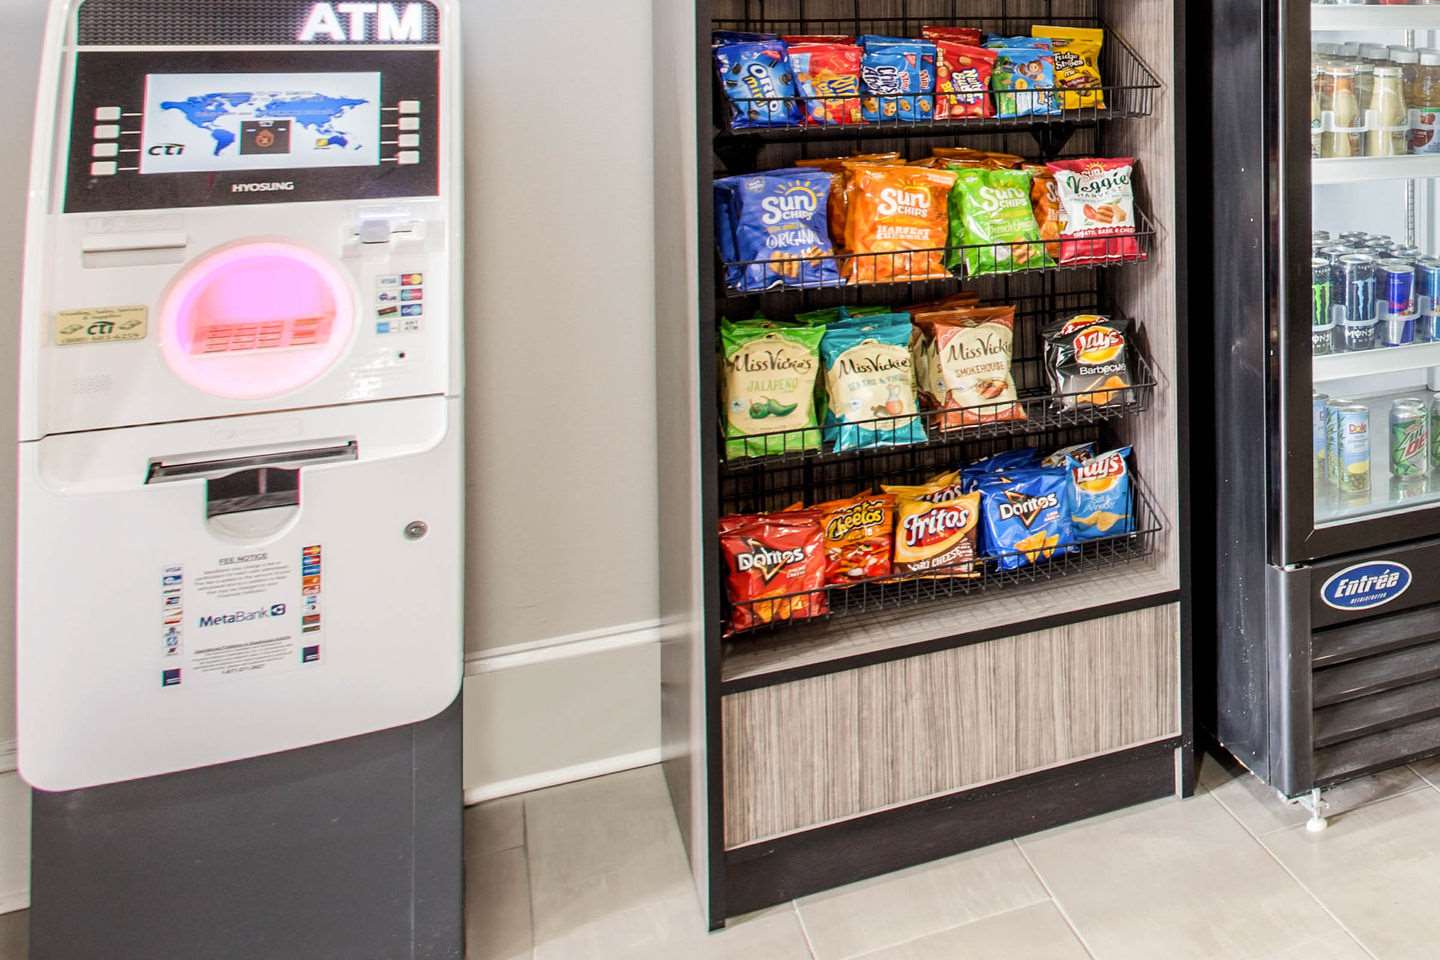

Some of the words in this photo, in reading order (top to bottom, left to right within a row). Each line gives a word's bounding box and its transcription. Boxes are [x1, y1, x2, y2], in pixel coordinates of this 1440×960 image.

[299, 2, 424, 41] ATM
[232, 181, 294, 193] HYOSUNG
[1066, 171, 1131, 195] Veggie
[761, 191, 817, 224] Sun
[878, 187, 931, 216] Sun
[979, 185, 1025, 211] Sun
[999, 198, 1028, 209] CHIPS
[897, 206, 929, 217] CHIPS
[955, 361, 1005, 378] SMOKEHOUSE
[1079, 362, 1127, 376] Barbecue
[999, 493, 1059, 520] Doritos
[829, 509, 883, 539] Cheetos
[903, 507, 970, 546] Fritos
[738, 547, 805, 571] Doritos
[1334, 569, 1401, 599] Entrée
[199, 606, 269, 628] MetaBank
